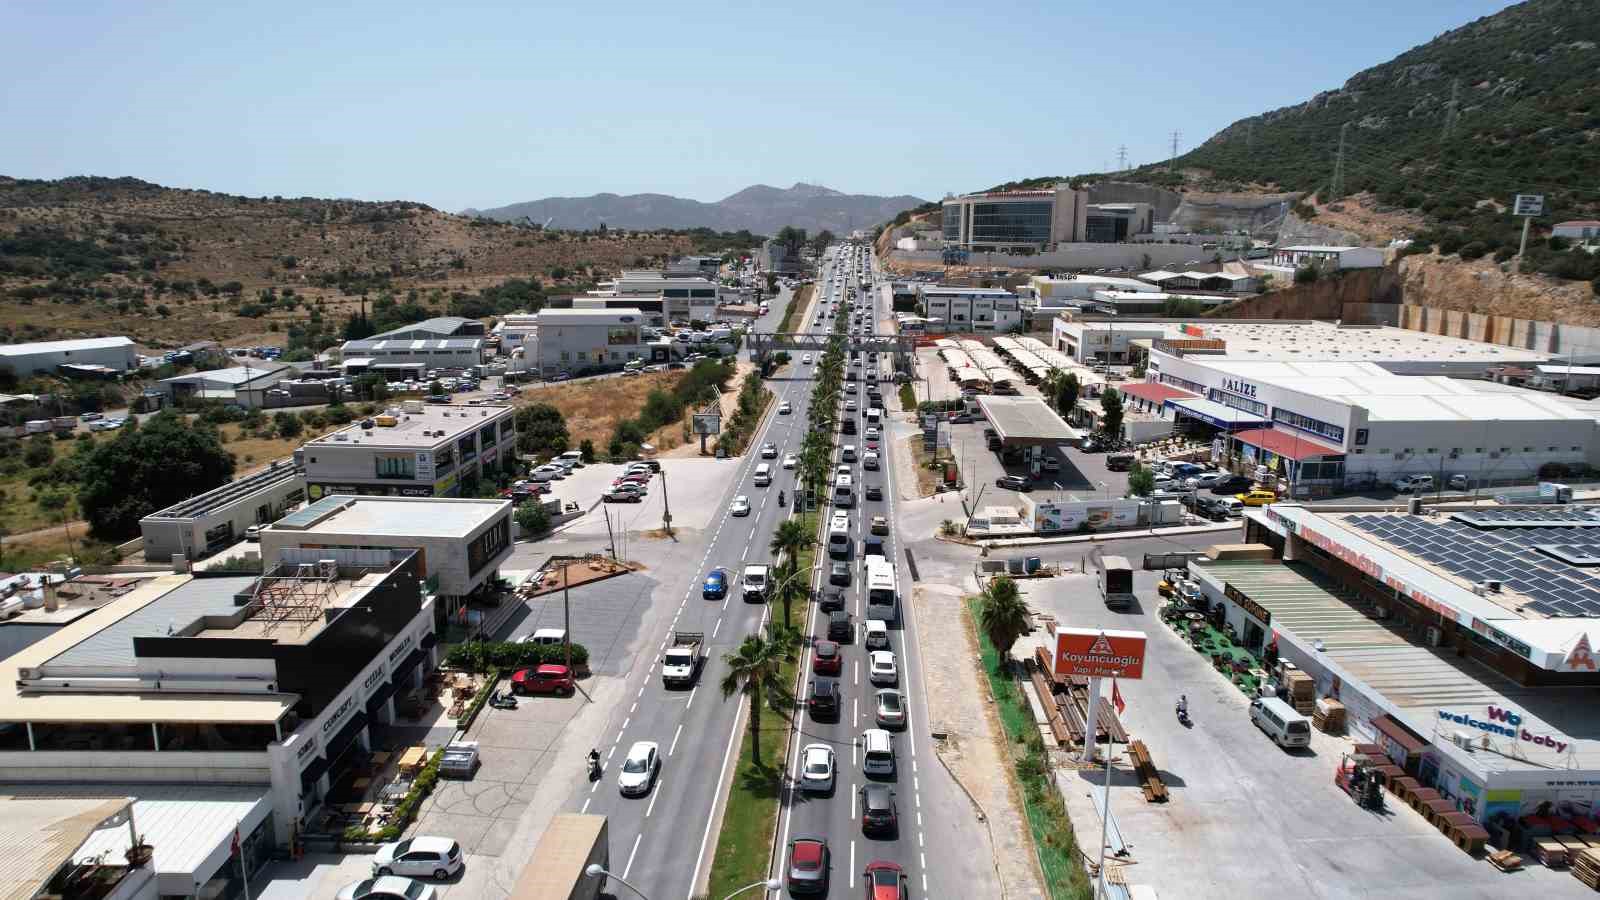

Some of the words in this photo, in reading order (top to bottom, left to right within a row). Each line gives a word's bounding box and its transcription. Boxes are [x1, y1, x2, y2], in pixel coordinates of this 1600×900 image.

[1227, 379, 1257, 399] ALİZE
[1439, 710, 1515, 737] welcome
[1521, 729, 1568, 753] baby
